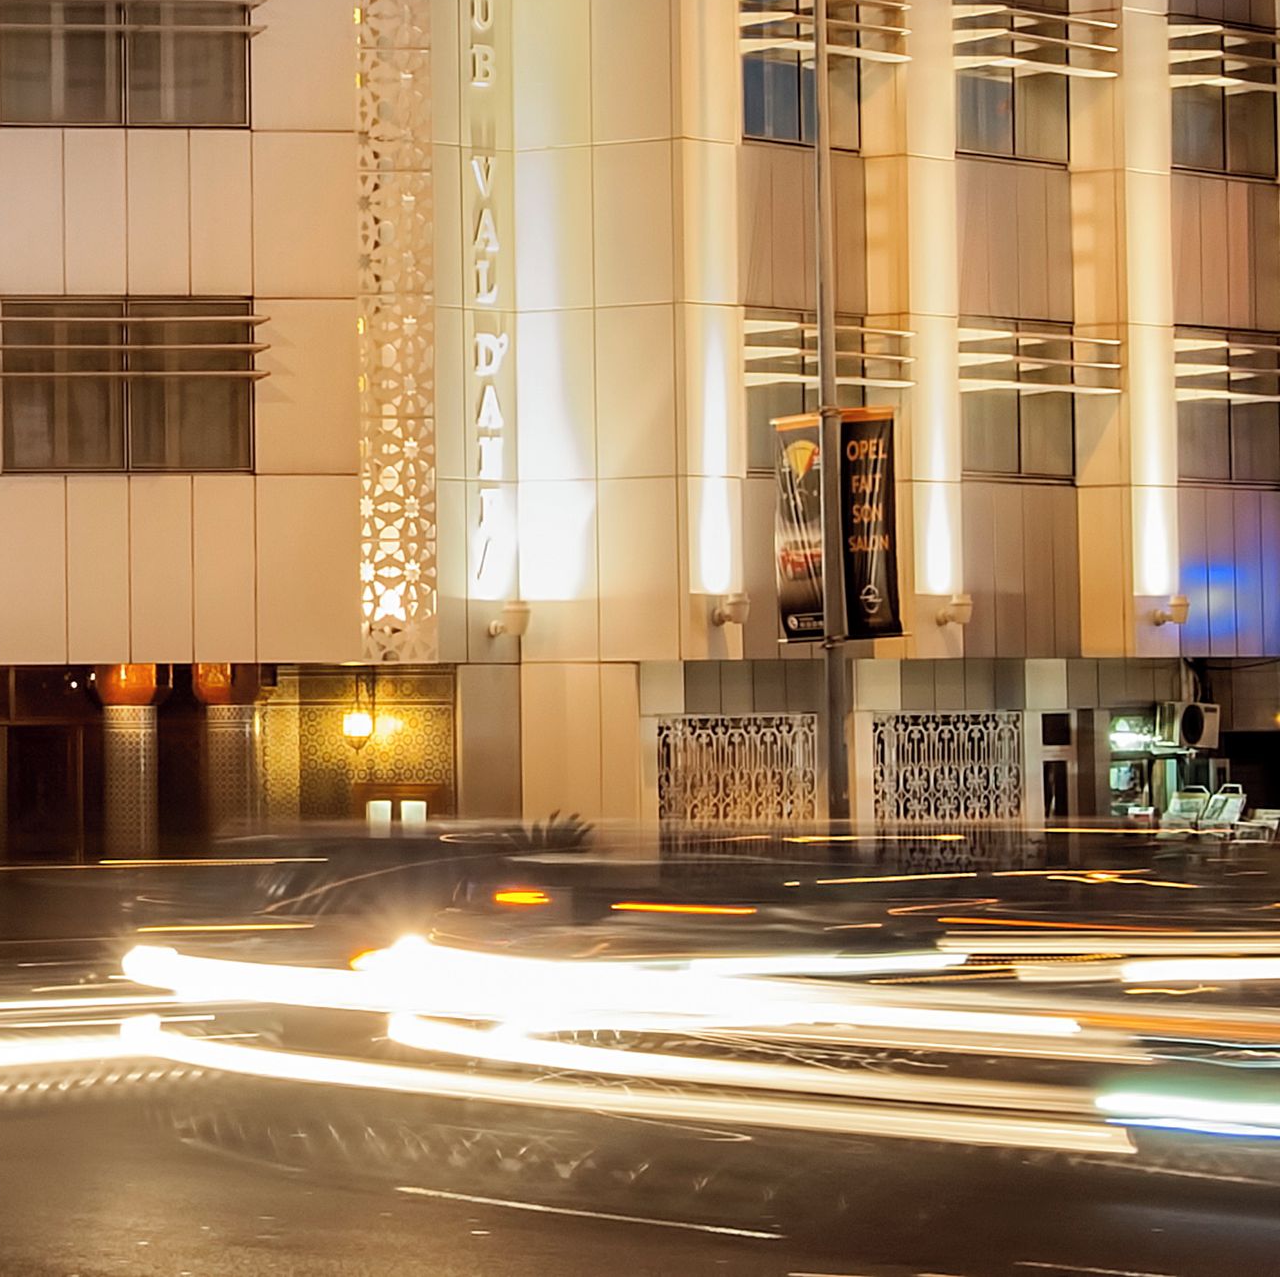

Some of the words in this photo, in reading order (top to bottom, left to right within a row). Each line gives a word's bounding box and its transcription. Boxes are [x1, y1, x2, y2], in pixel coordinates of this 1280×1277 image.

[471, 156, 500, 304] VAL
[846, 440, 887, 462] OPEL
[852, 474, 882, 494] FAIT
[852, 504, 883, 524] SON
[848, 534, 889, 553] SALON
